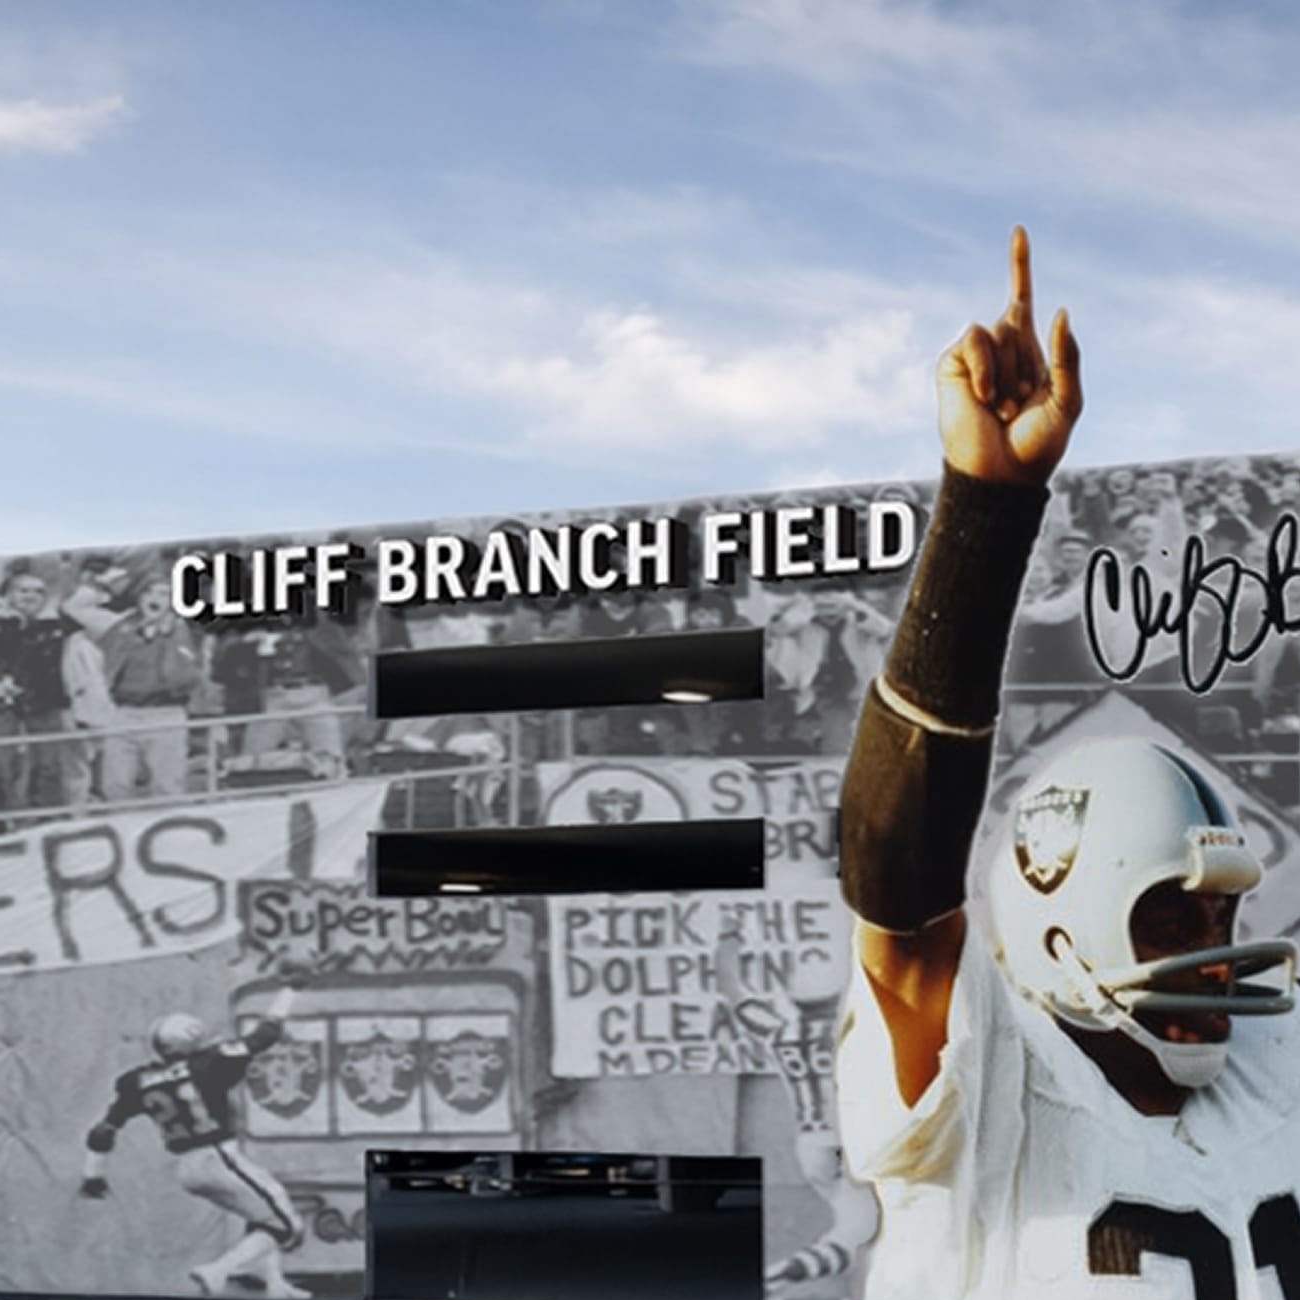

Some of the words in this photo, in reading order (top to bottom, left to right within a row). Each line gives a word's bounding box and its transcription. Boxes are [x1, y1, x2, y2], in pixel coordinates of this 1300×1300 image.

[171, 543, 350, 618] CLIFF
[378, 517, 672, 603] BRANCH
[703, 501, 917, 581] FIELD
[254, 891, 394, 952] Super
[567, 951, 831, 998] DOLPHIN
